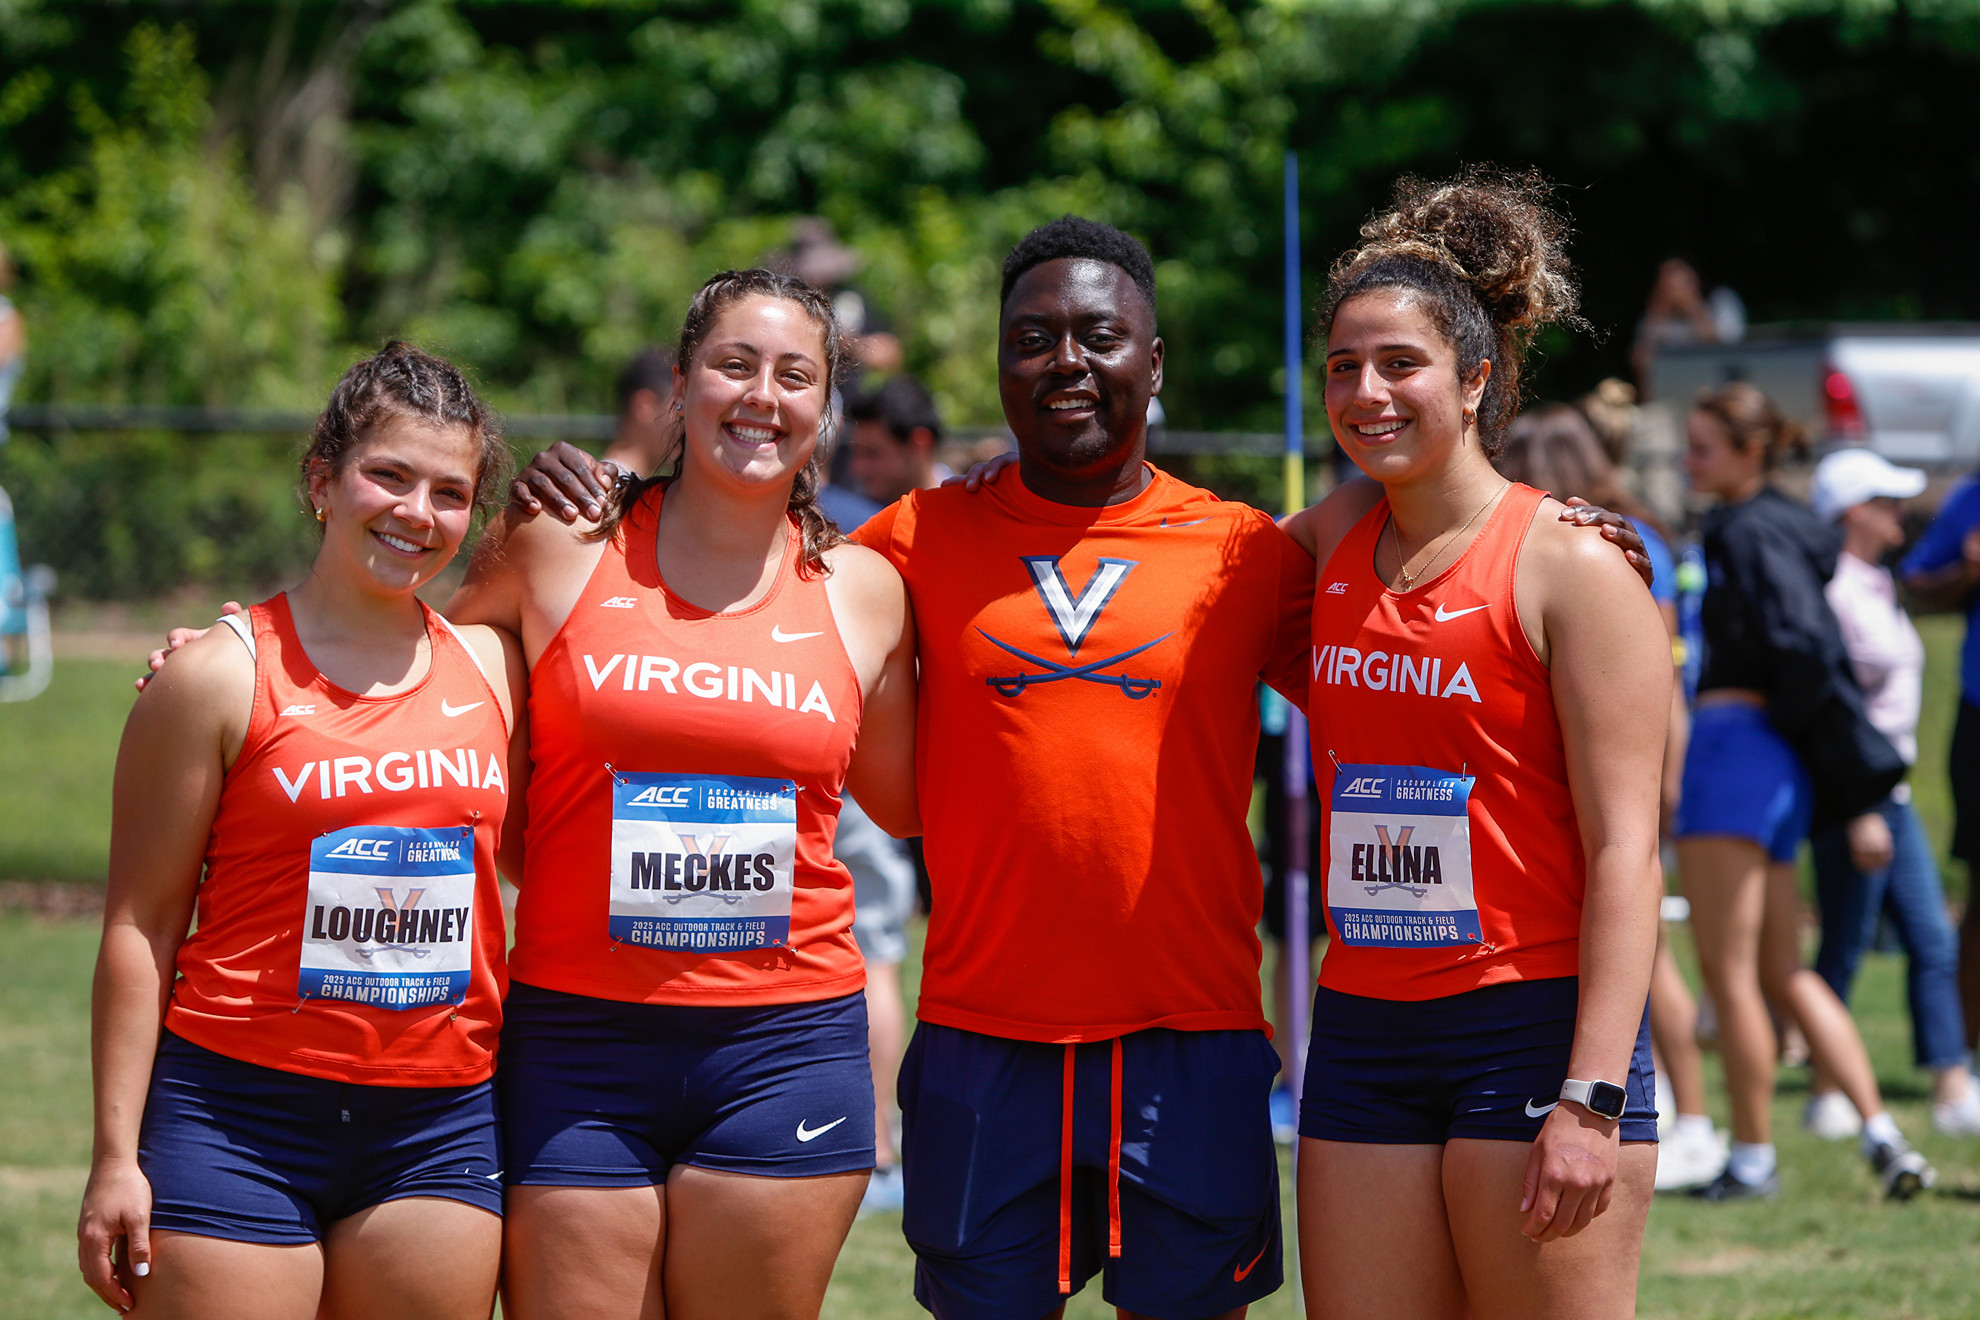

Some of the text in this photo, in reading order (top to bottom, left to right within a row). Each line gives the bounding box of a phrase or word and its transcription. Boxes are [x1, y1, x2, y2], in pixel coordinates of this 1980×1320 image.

[1326, 582, 1349, 594] ACC
[600, 596, 638, 609] ACC
[1313, 645, 1482, 703] VIRGINIA
[583, 654, 836, 723] VIRGINIA
[280, 704, 316, 716] ACC
[272, 749, 506, 803] VIRGINIA
[1342, 777, 1456, 796] ACC ACCOMPLISH
[1396, 787, 1453, 801] GREATNESS
[629, 786, 777, 806] ACC ACCOMPLISH
[707, 796, 778, 811] GREATNESS
[327, 838, 393, 860] ACC
[407, 848, 461, 863] GREATNESS
[631, 852, 774, 891] MECKES
[1351, 844, 1442, 884] ELLINA
[311, 905, 469, 943] LOUGHNEY
[633, 921, 765, 932] 2025 ACC OUTDOOR TRACK & FIELD
[1344, 913, 1455, 925] 2025 ACC OUTDOOR TRACK & FIELD
[631, 930, 765, 948] CHAMPIONSHIPS
[1344, 923, 1459, 941] CHAMPIONSHIPS
[323, 975, 450, 987] 2025 ACC OUTDOOR TRACK & FIELD
[320, 984, 449, 1004] CHAMPIONSHIPS
